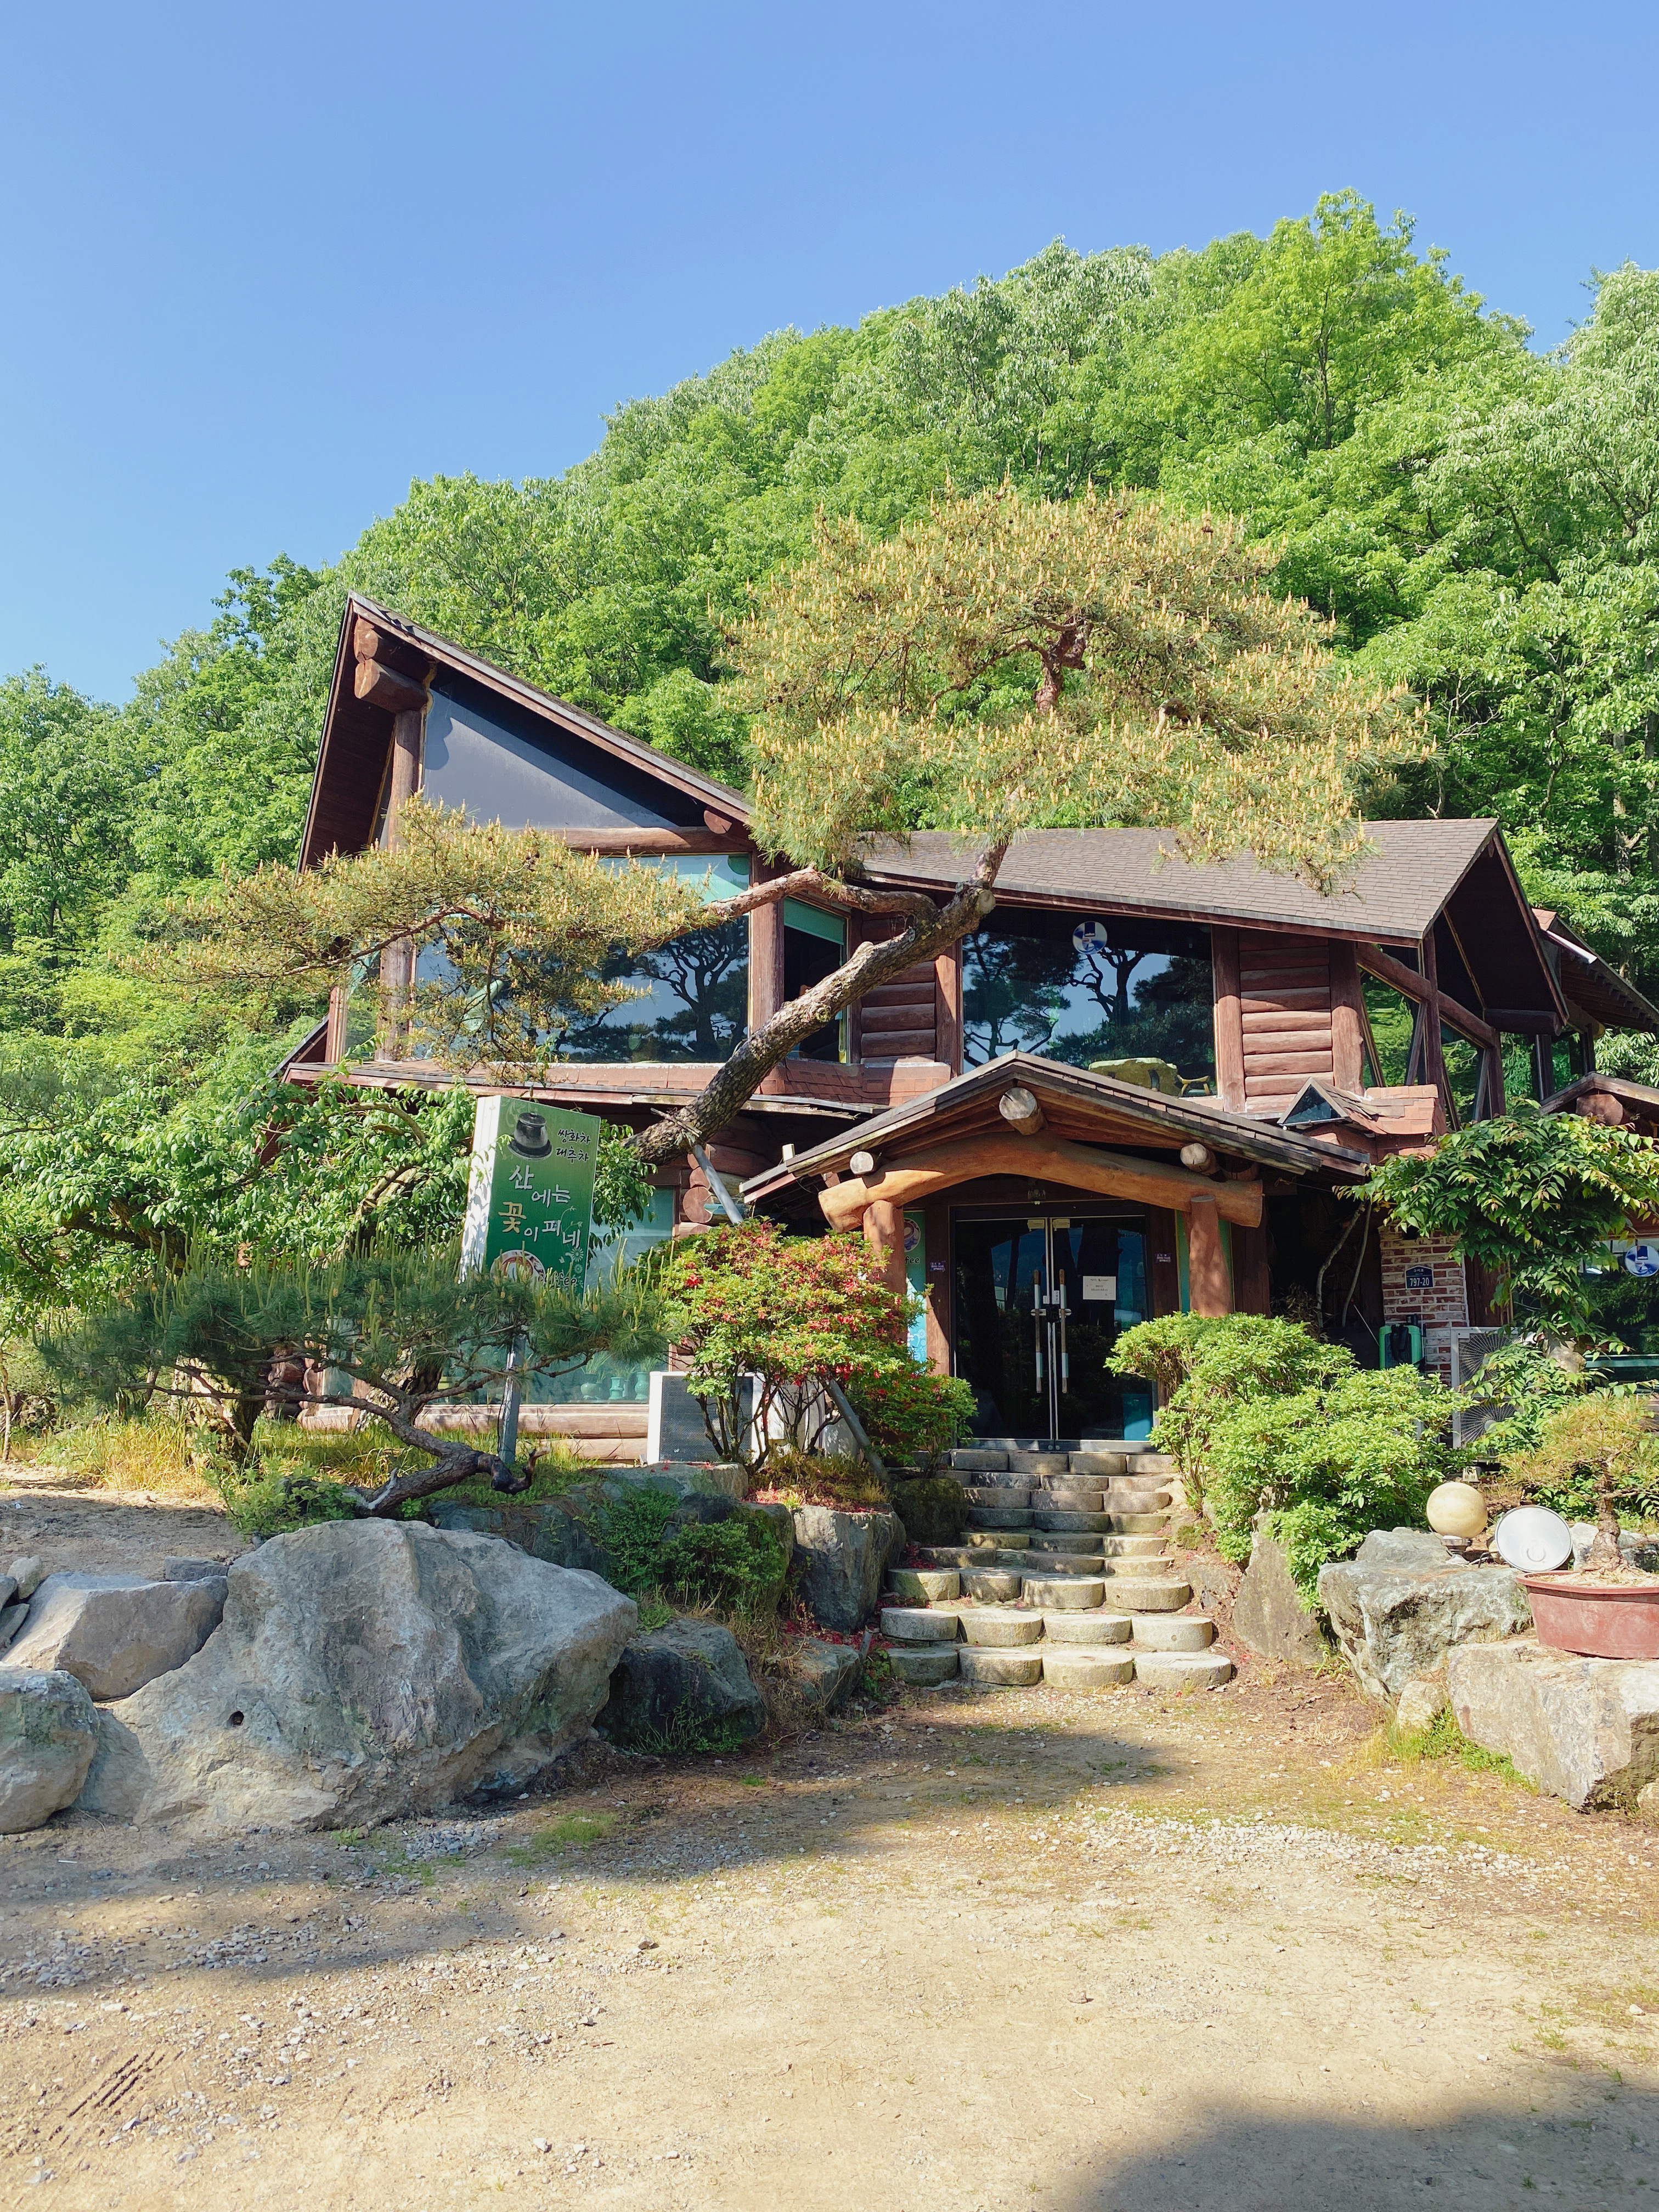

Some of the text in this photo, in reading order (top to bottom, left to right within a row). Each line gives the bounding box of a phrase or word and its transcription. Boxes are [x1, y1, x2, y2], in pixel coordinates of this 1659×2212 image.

[557, 1128, 591, 1144] 쌍화차
[556, 1146, 589, 1163] 대추차
[538, 1271, 577, 1287] cffee
[1409, 1277, 1429, 1286] 797-20
